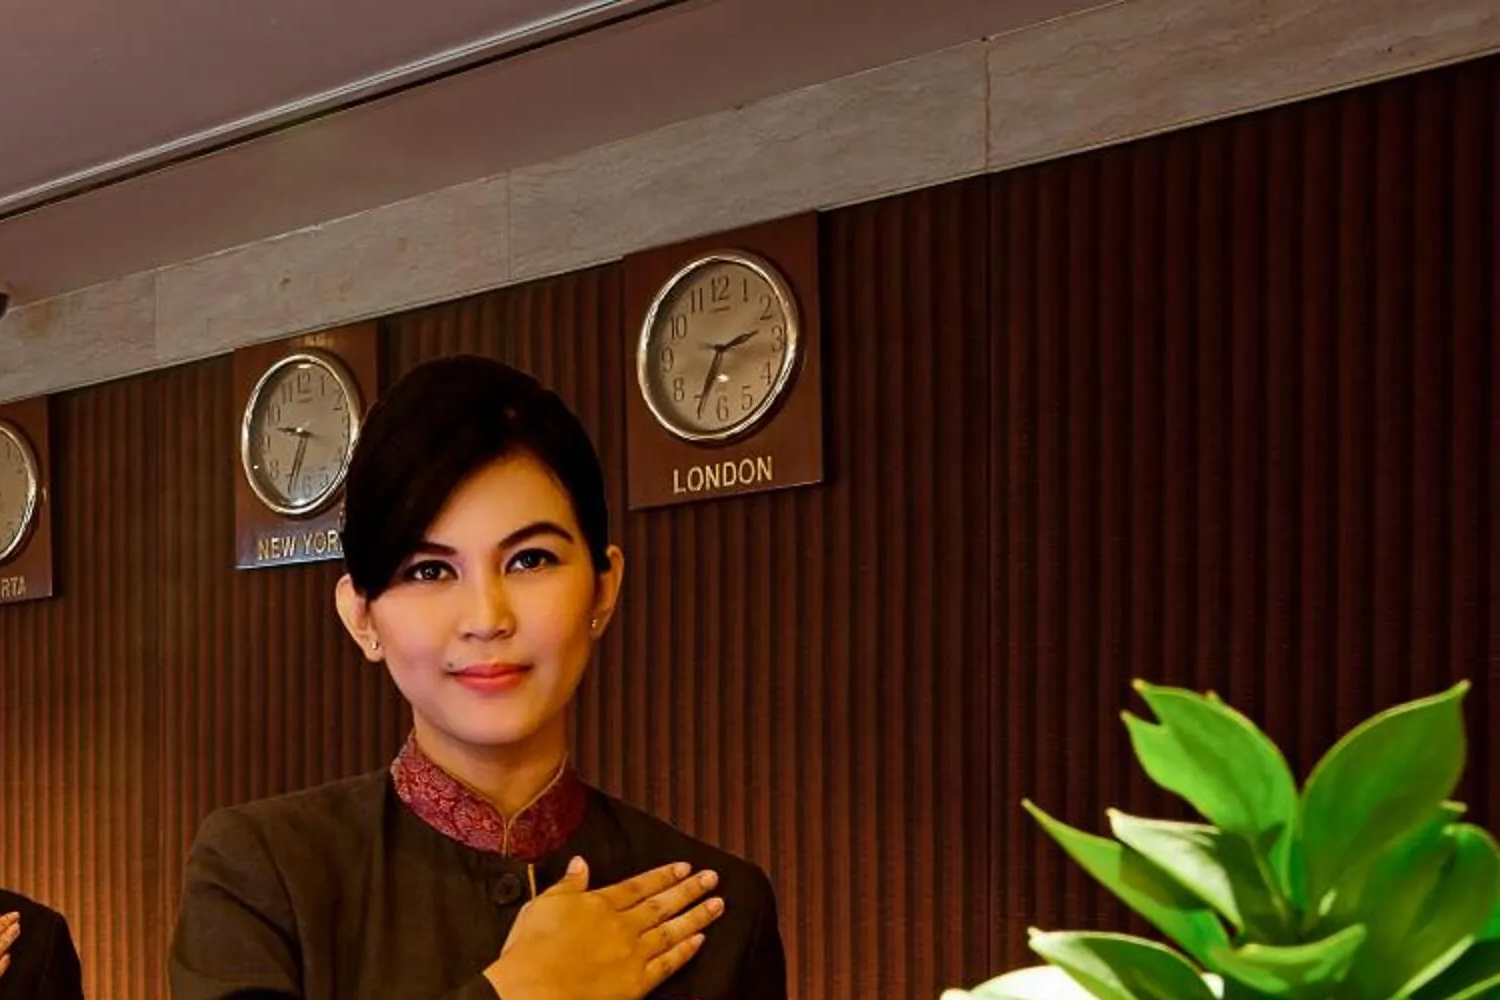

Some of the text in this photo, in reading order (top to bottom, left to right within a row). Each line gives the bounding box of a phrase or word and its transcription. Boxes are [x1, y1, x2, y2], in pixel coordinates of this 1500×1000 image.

[690, 287, 703, 314] 11
[711, 275, 731, 303] 12
[741, 277, 748, 303] 1
[759, 294, 773, 321] 2
[671, 314, 687, 340] 10
[771, 325, 783, 353] 3
[662, 347, 674, 373] 9
[760, 360, 772, 386] 4
[281, 382, 293, 405] 11
[297, 372, 312, 394] 12
[673, 377, 684, 402] 8
[716, 394, 730, 423] 6
[741, 385, 753, 411] 5
[673, 455, 773, 494] LONDON
[258, 529, 343, 561] NEW YOR
